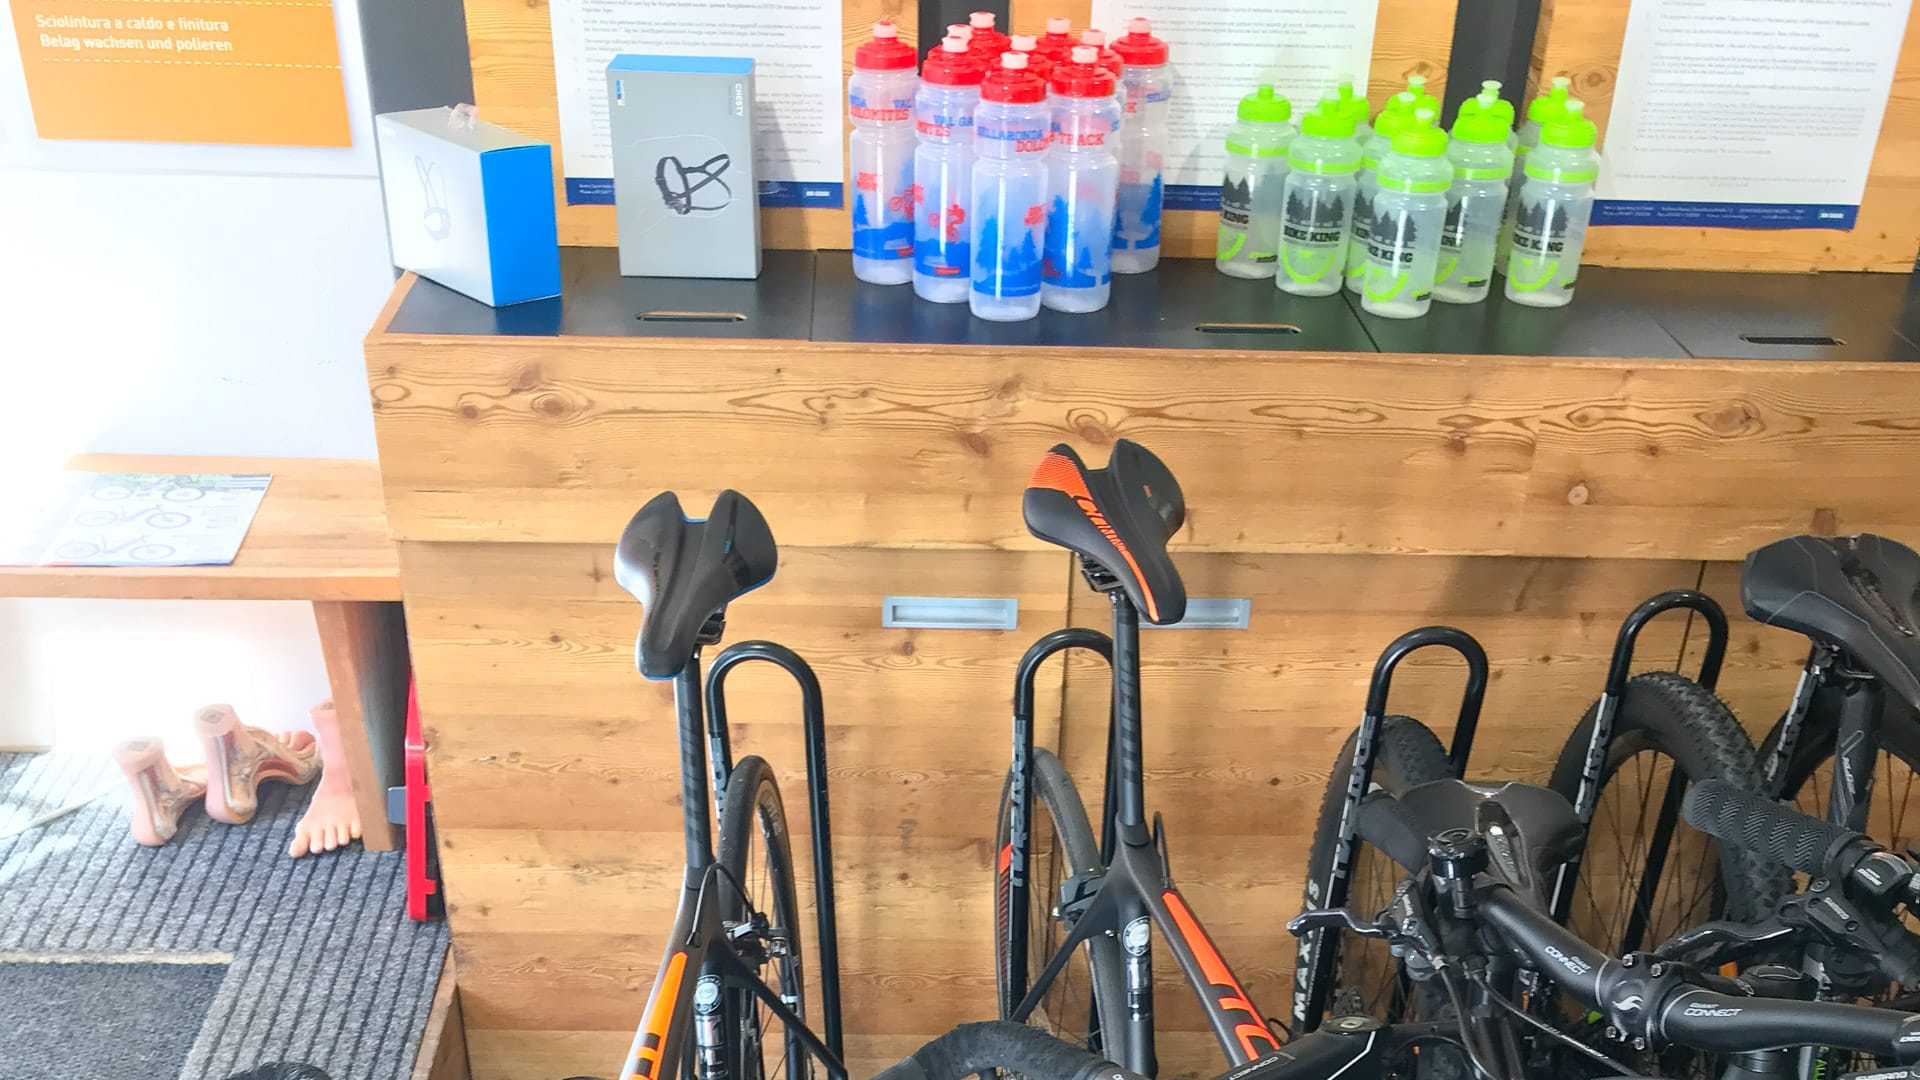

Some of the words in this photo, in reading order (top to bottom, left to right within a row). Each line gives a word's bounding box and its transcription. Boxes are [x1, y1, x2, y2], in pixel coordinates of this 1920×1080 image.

[36, 14, 111, 29] Sciolintura
[115, 19, 123, 29] a
[126, 16, 163, 30] caldo
[167, 20, 175, 30] e
[178, 17, 229, 31] finitura
[40, 34, 80, 50] Belag
[83, 36, 143, 49] wachsen
[147, 37, 172, 50] und
[176, 38, 232, 52] polieren
[1310, 230, 1341, 243] KING
[1530, 238, 1564, 253] KNG
[1294, 878, 1321, 1022] MAXS
[1544, 945, 1587, 976] CONNECT
[1683, 1007, 1744, 1017] CONNECT
